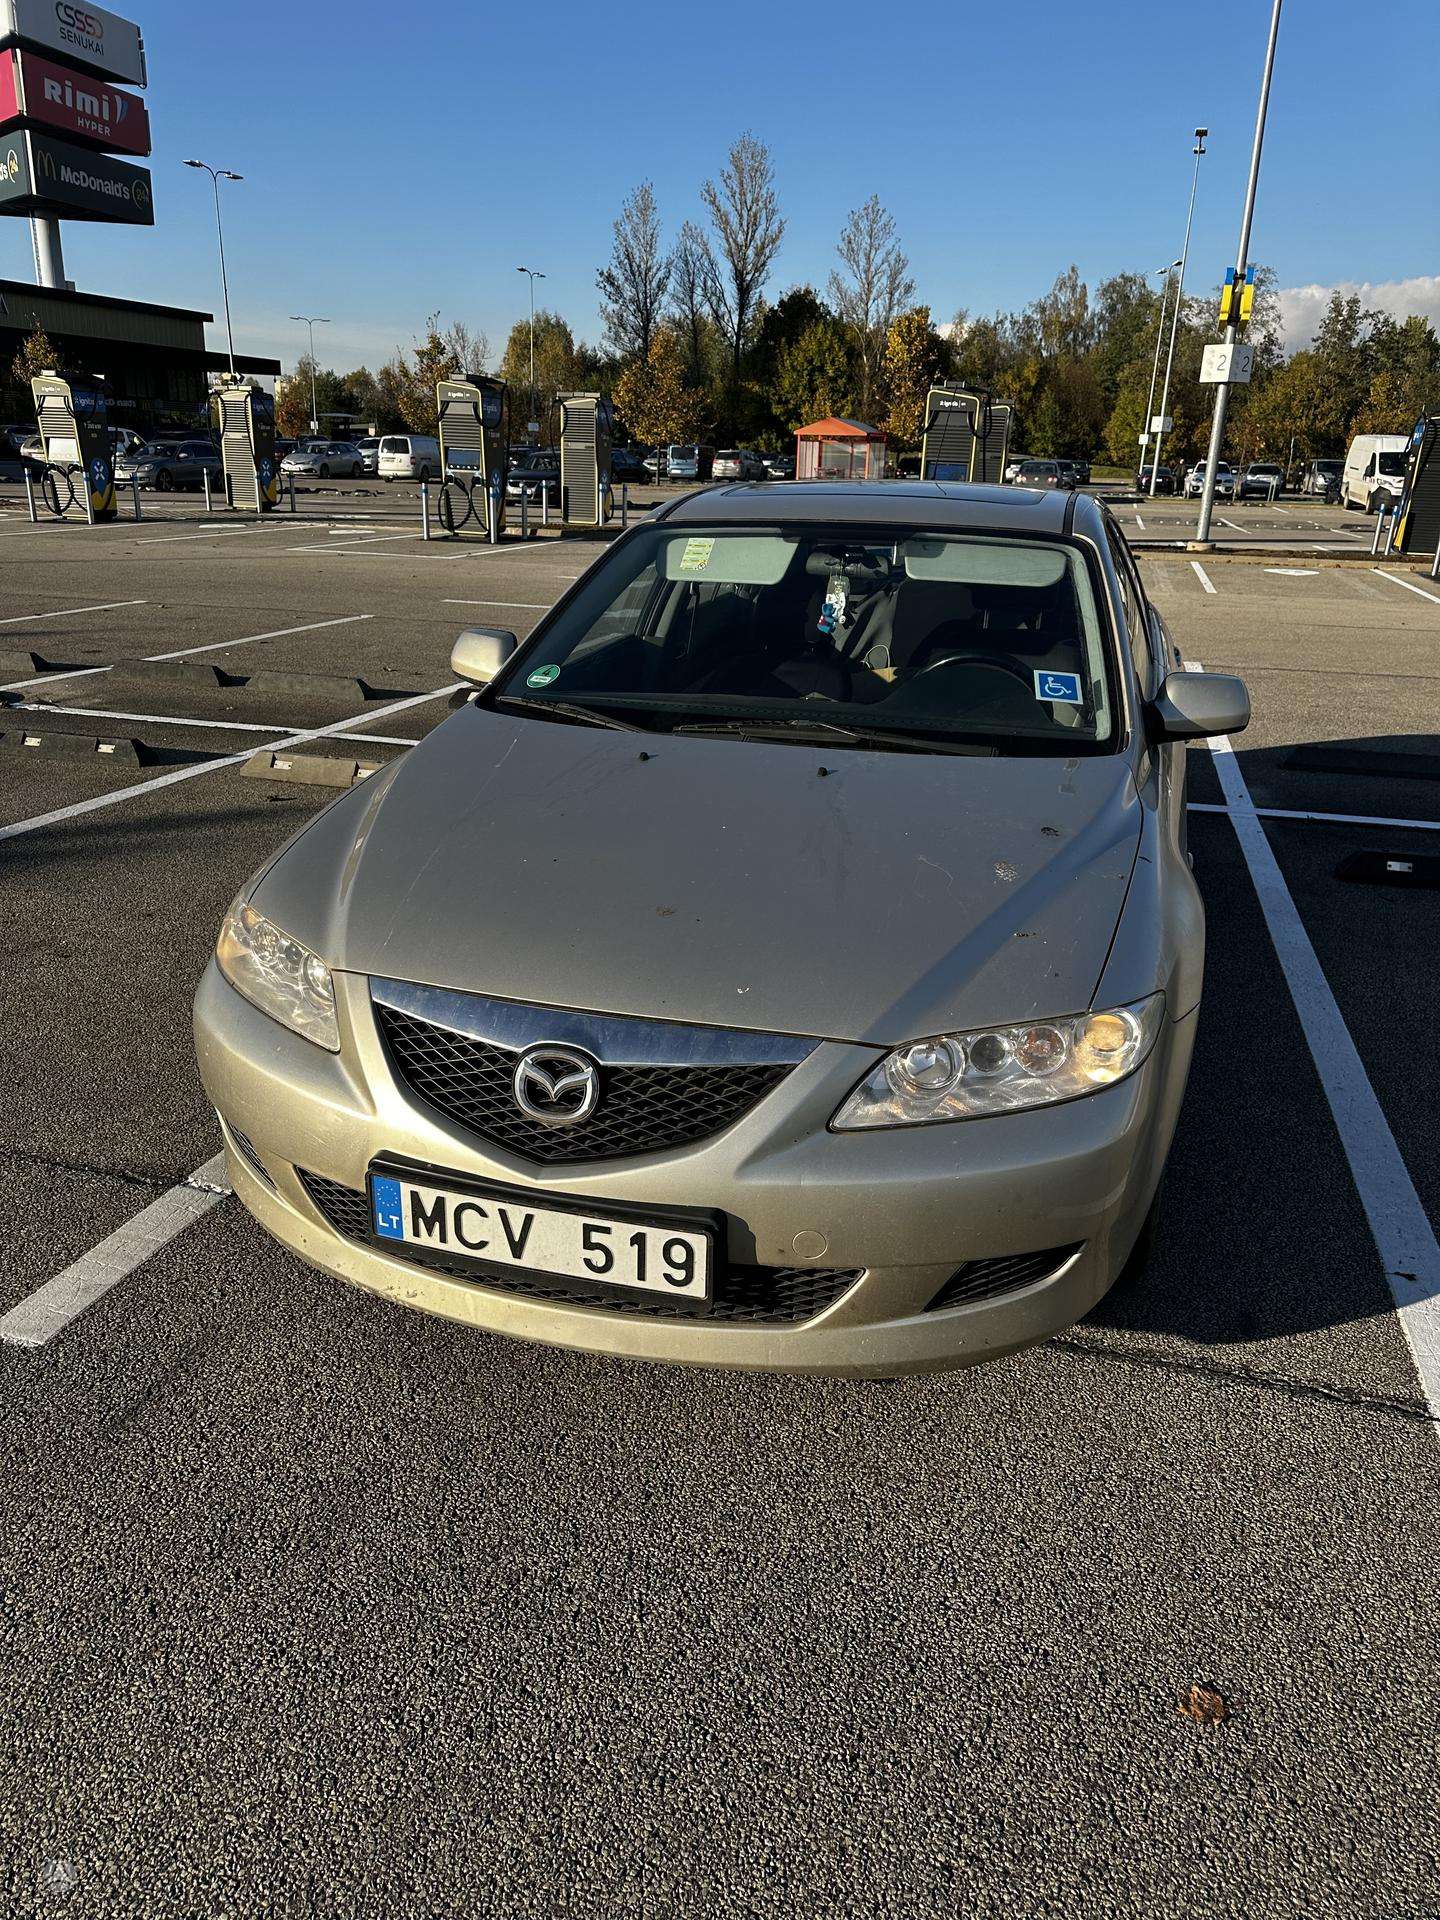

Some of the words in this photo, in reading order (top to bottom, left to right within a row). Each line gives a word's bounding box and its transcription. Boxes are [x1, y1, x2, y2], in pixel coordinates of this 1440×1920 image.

[60, 27, 104, 56] SENUKAI
[44, 77, 110, 121] Rimi
[77, 116, 111, 137] HYPER
[61, 165, 130, 200] McDonald's
[1217, 354, 1227, 371] 2
[1241, 355, 1250, 372] 2
[378, 1212, 400, 1229] LT
[409, 1189, 535, 1260] MCV
[582, 1222, 695, 1288] 519
